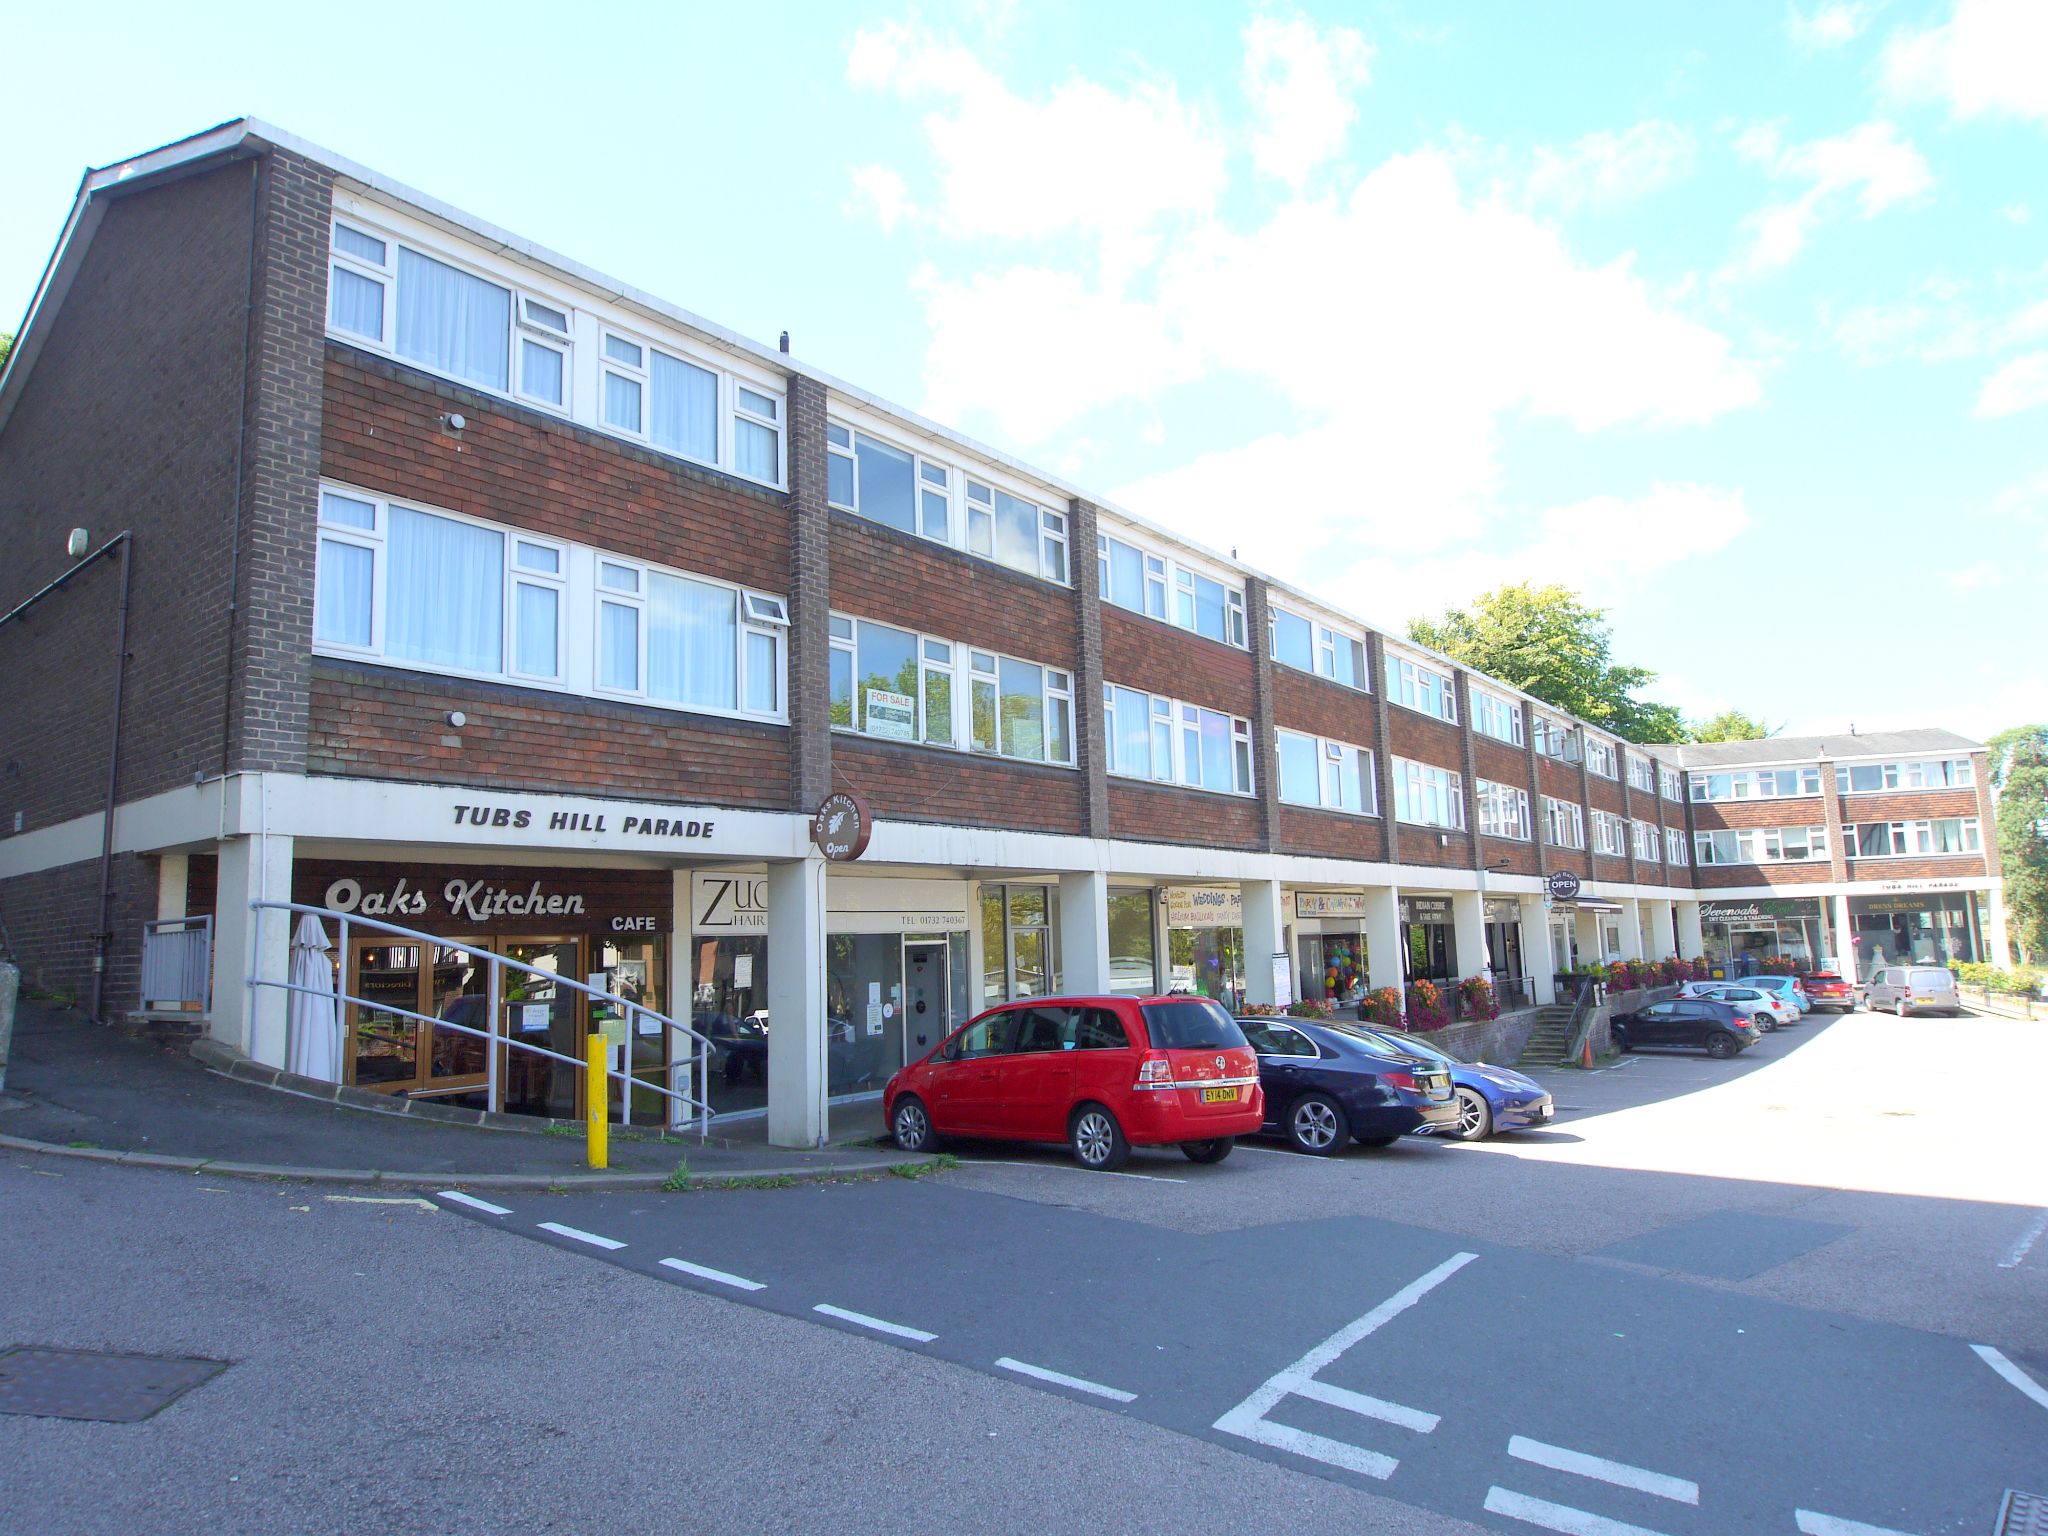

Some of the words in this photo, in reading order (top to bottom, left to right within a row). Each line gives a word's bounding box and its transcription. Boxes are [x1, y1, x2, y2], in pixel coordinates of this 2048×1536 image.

[871, 691, 888, 703] FOR
[890, 696, 910, 707] SALE
[816, 800, 832, 833] Oaks
[833, 794, 860, 829] Kitchen
[454, 805, 532, 829] TUBS
[549, 811, 607, 833] HILL
[622, 816, 715, 839] PARADE
[826, 842, 849, 858] Open
[1551, 880, 1577, 889] OPEN
[325, 878, 428, 916] Oaks
[444, 878, 586, 921] Kitchen
[1192, 891, 1226, 907] WEDDINGS
[1318, 896, 1326, 911] &
[1415, 901, 1430, 910] INDIAN
[1431, 901, 1446, 911] CUISINE
[1698, 902, 1760, 918] Sevenoaks
[611, 916, 656, 931] CAFE
[734, 914, 766, 926] HAIR
[919, 915, 940, 926] 01732
[942, 915, 966, 926] 740367
